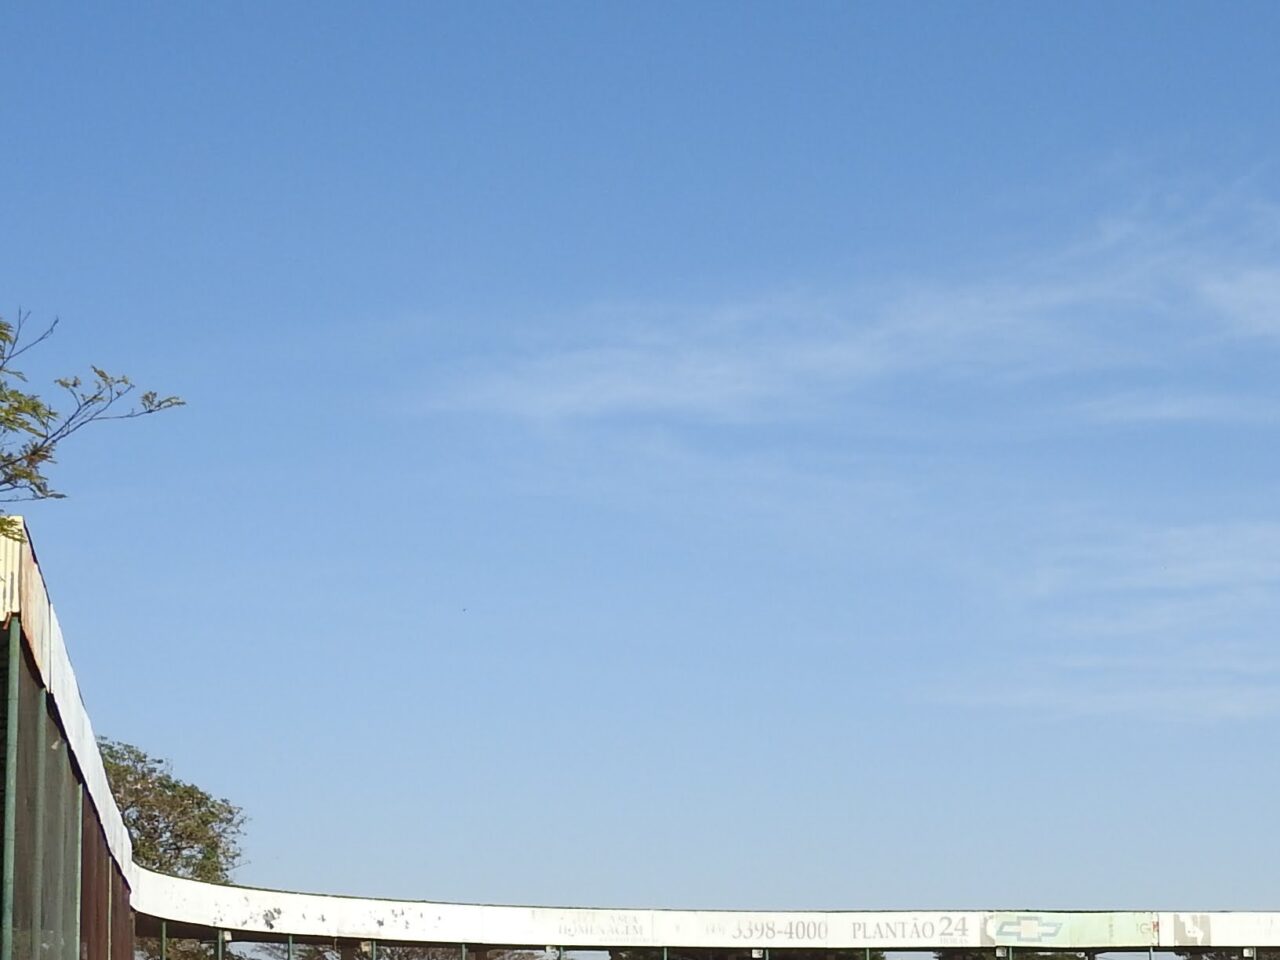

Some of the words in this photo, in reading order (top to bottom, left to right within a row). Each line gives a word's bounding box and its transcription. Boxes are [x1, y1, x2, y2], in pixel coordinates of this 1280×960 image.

[732, 920, 828, 939] 3398-4000
[852, 917, 935, 939] PLANTÃO
[939, 916, 969, 937] 24
